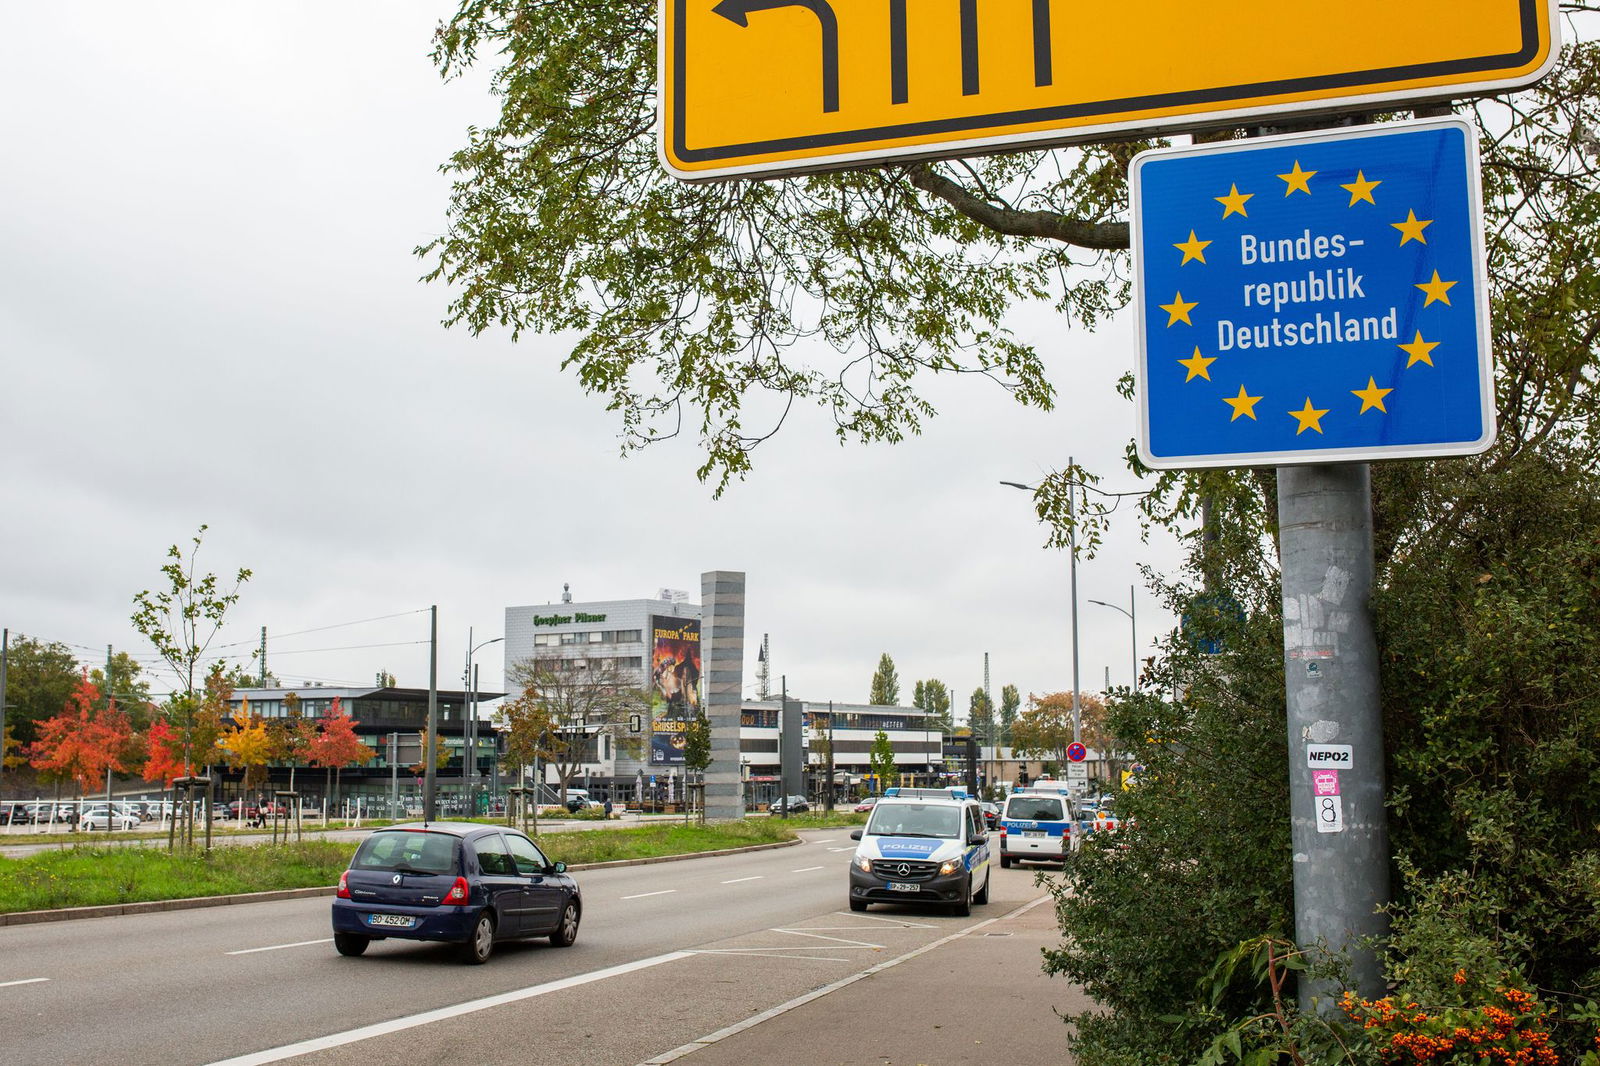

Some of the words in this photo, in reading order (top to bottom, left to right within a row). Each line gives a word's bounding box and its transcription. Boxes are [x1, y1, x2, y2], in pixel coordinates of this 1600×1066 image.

[1240, 229, 1365, 266] Bundes-
[1243, 267, 1366, 313] republik
[1217, 307, 1398, 351] Deutschland
[575, 612, 607, 623] Pilsner
[654, 628, 680, 640] EUROPA
[682, 631, 700, 642] PARK
[1309, 751, 1349, 763] NEPO2
[1006, 822, 1032, 830] POLIZEI
[882, 843, 933, 852] POLIZEI
